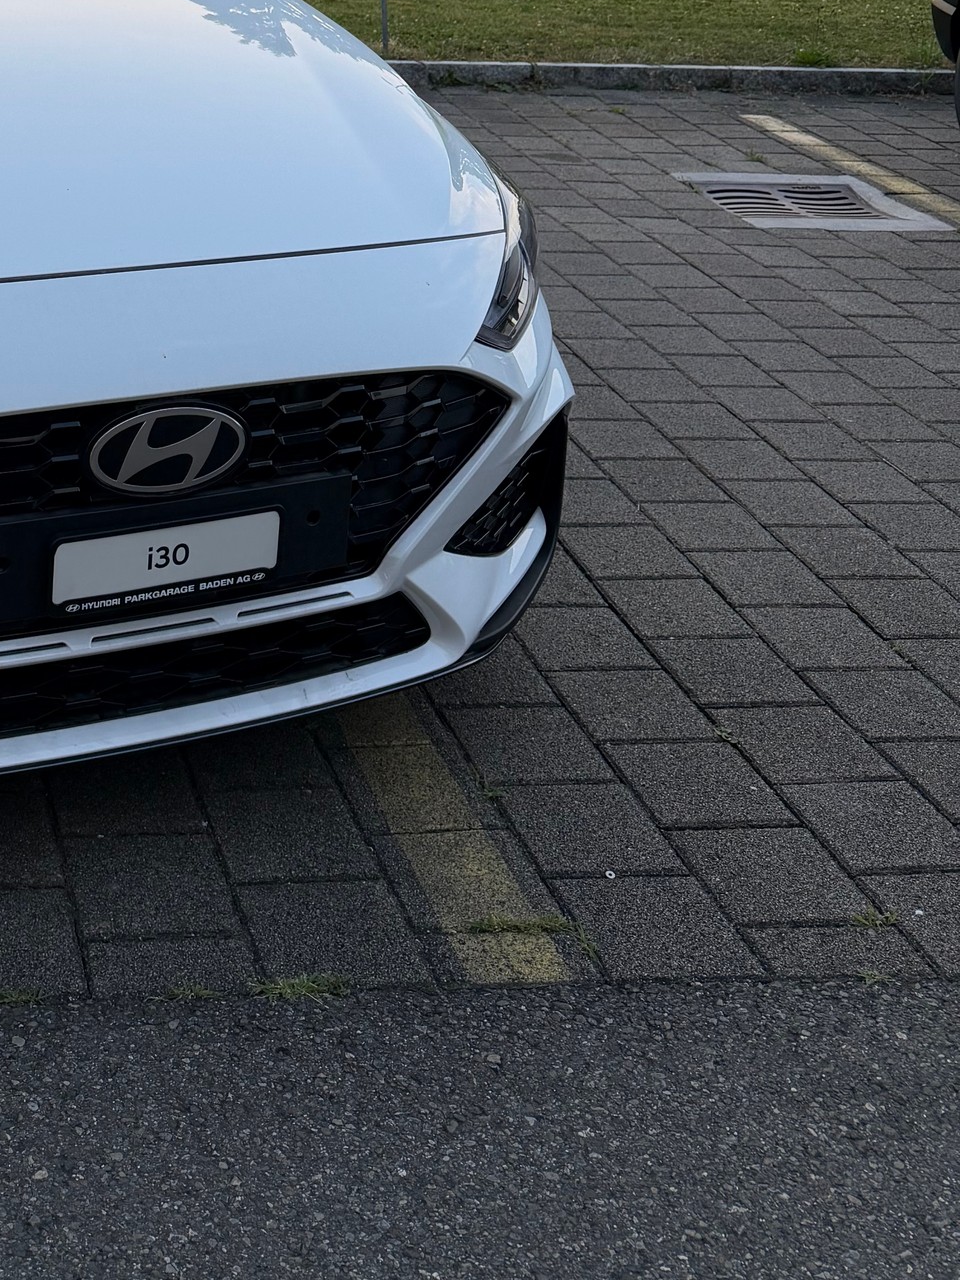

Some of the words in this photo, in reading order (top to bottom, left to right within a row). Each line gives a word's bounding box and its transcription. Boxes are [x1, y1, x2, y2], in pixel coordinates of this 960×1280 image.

[146, 543, 190, 570] i30
[81, 598, 121, 611] HYUNDAI
[124, 584, 195, 604] PARKGARAGE
[199, 577, 235, 591] BADEN
[236, 574, 251, 584] AG
